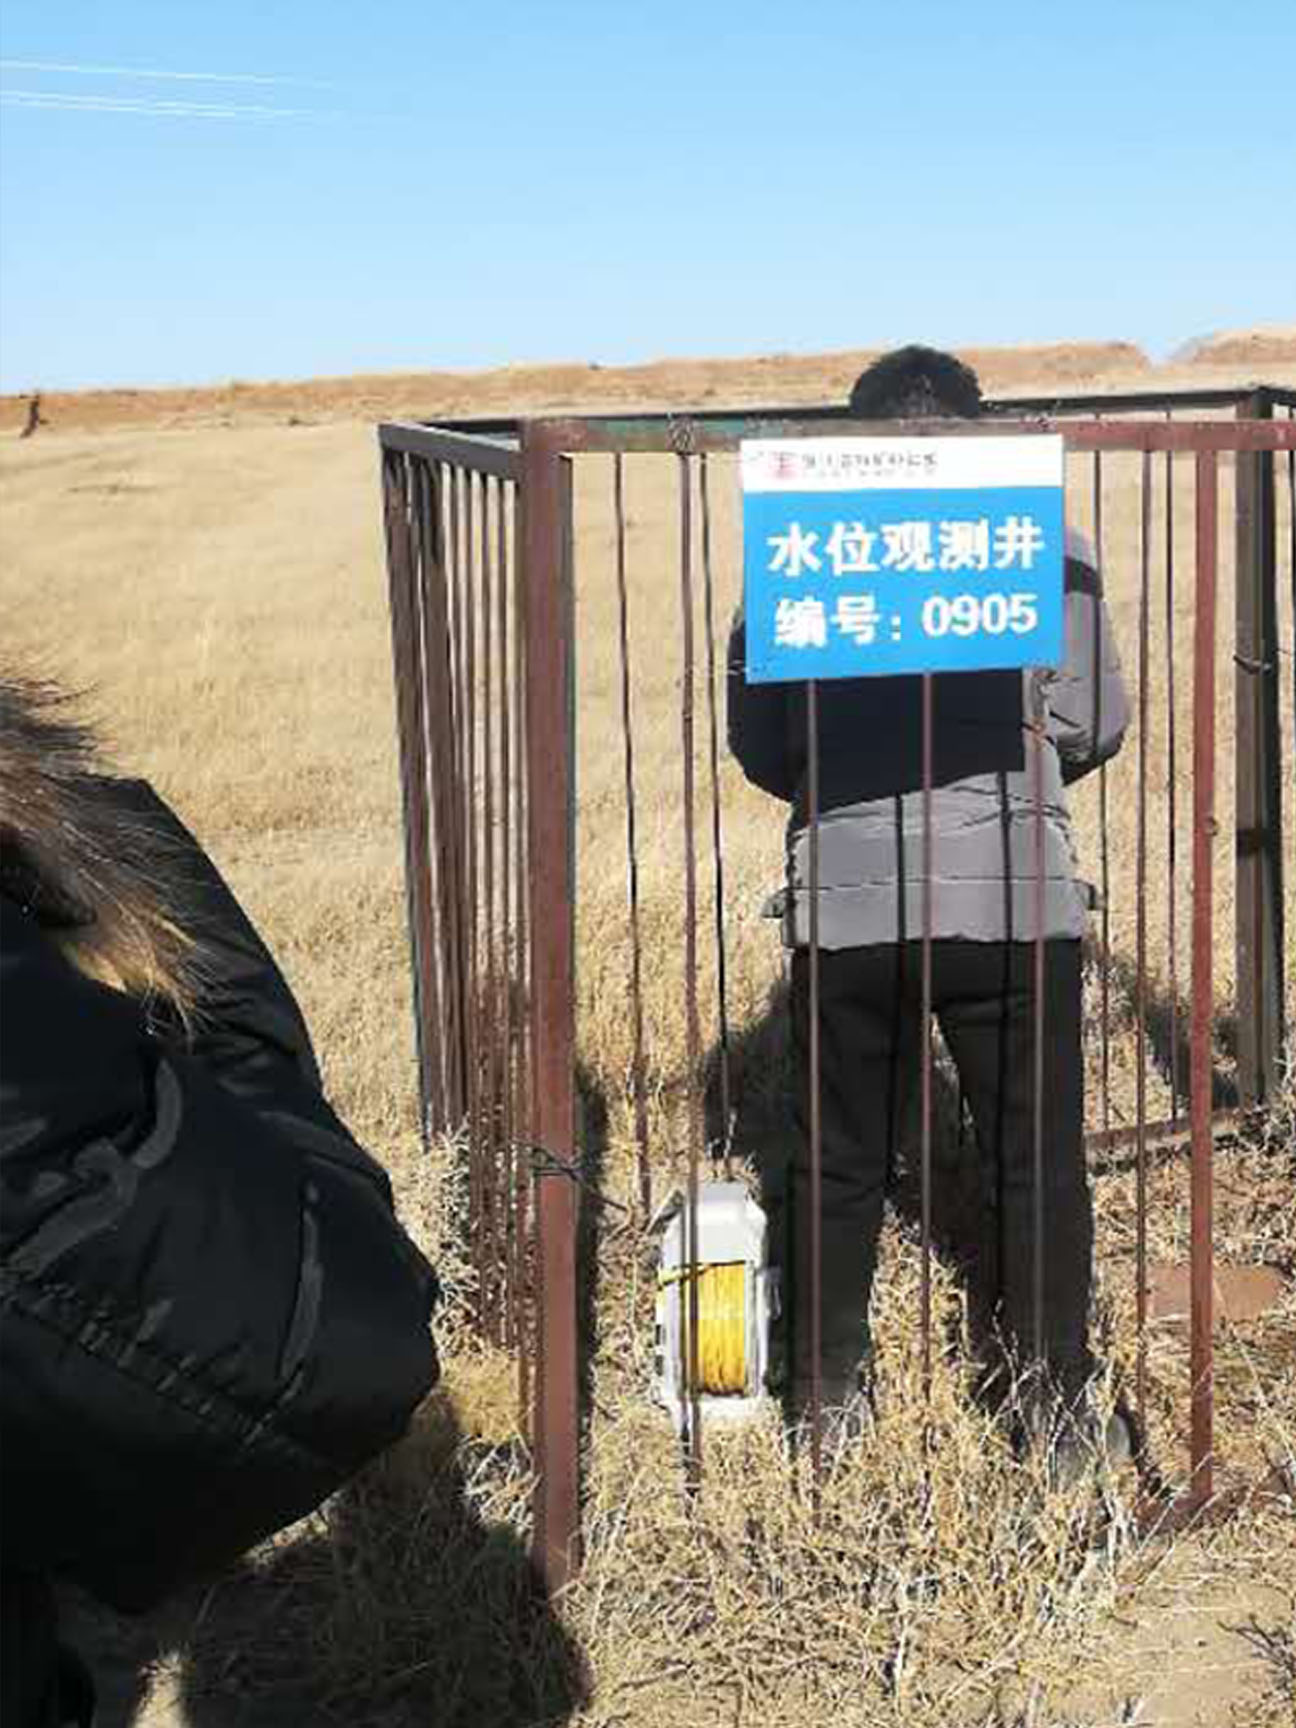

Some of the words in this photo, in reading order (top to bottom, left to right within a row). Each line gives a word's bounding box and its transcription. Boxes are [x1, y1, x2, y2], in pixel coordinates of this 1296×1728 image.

[766, 517, 1044, 576] 水位观测井
